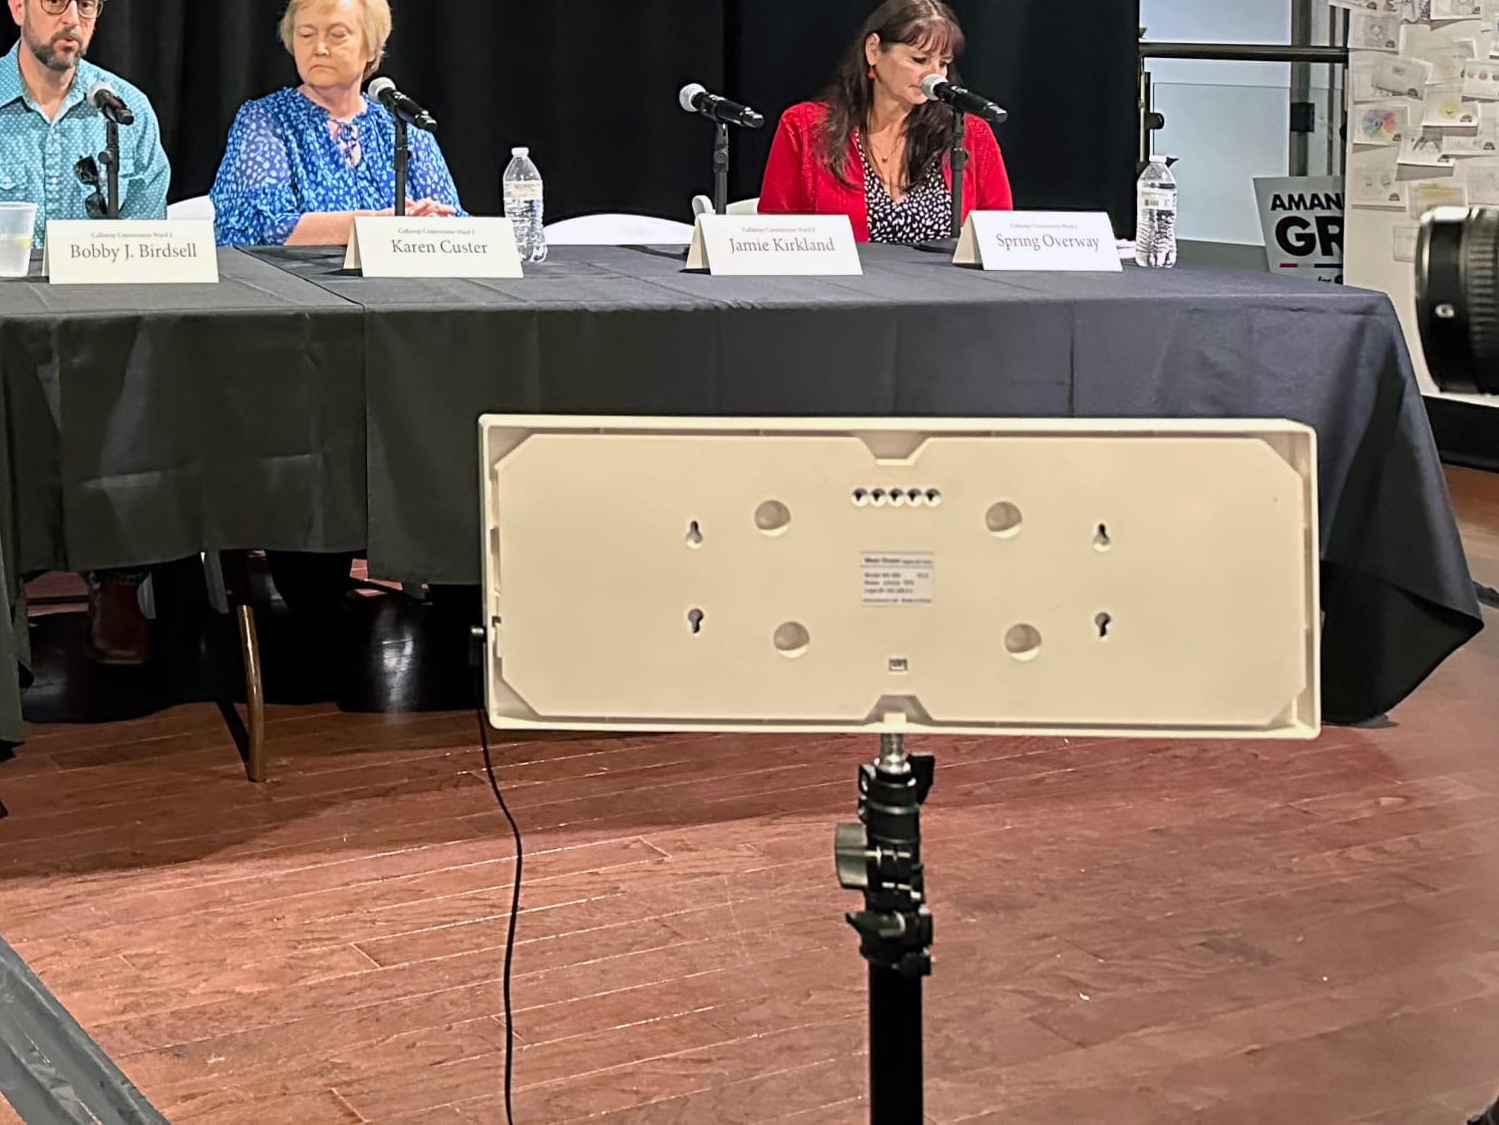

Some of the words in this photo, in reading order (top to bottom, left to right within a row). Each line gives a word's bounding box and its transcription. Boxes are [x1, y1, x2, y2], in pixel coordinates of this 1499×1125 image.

[1270, 193, 1346, 211] AMAN
[391, 239, 436, 253] Karen
[440, 239, 489, 254] Custer
[729, 237, 770, 254] Jamie
[773, 237, 835, 252] Kirkland
[996, 233, 1041, 251] Spring
[1042, 233, 1100, 252] Overway
[70, 243, 120, 263] Bobby
[124, 244, 134, 260] J.
[139, 242, 197, 258] Birdsell
